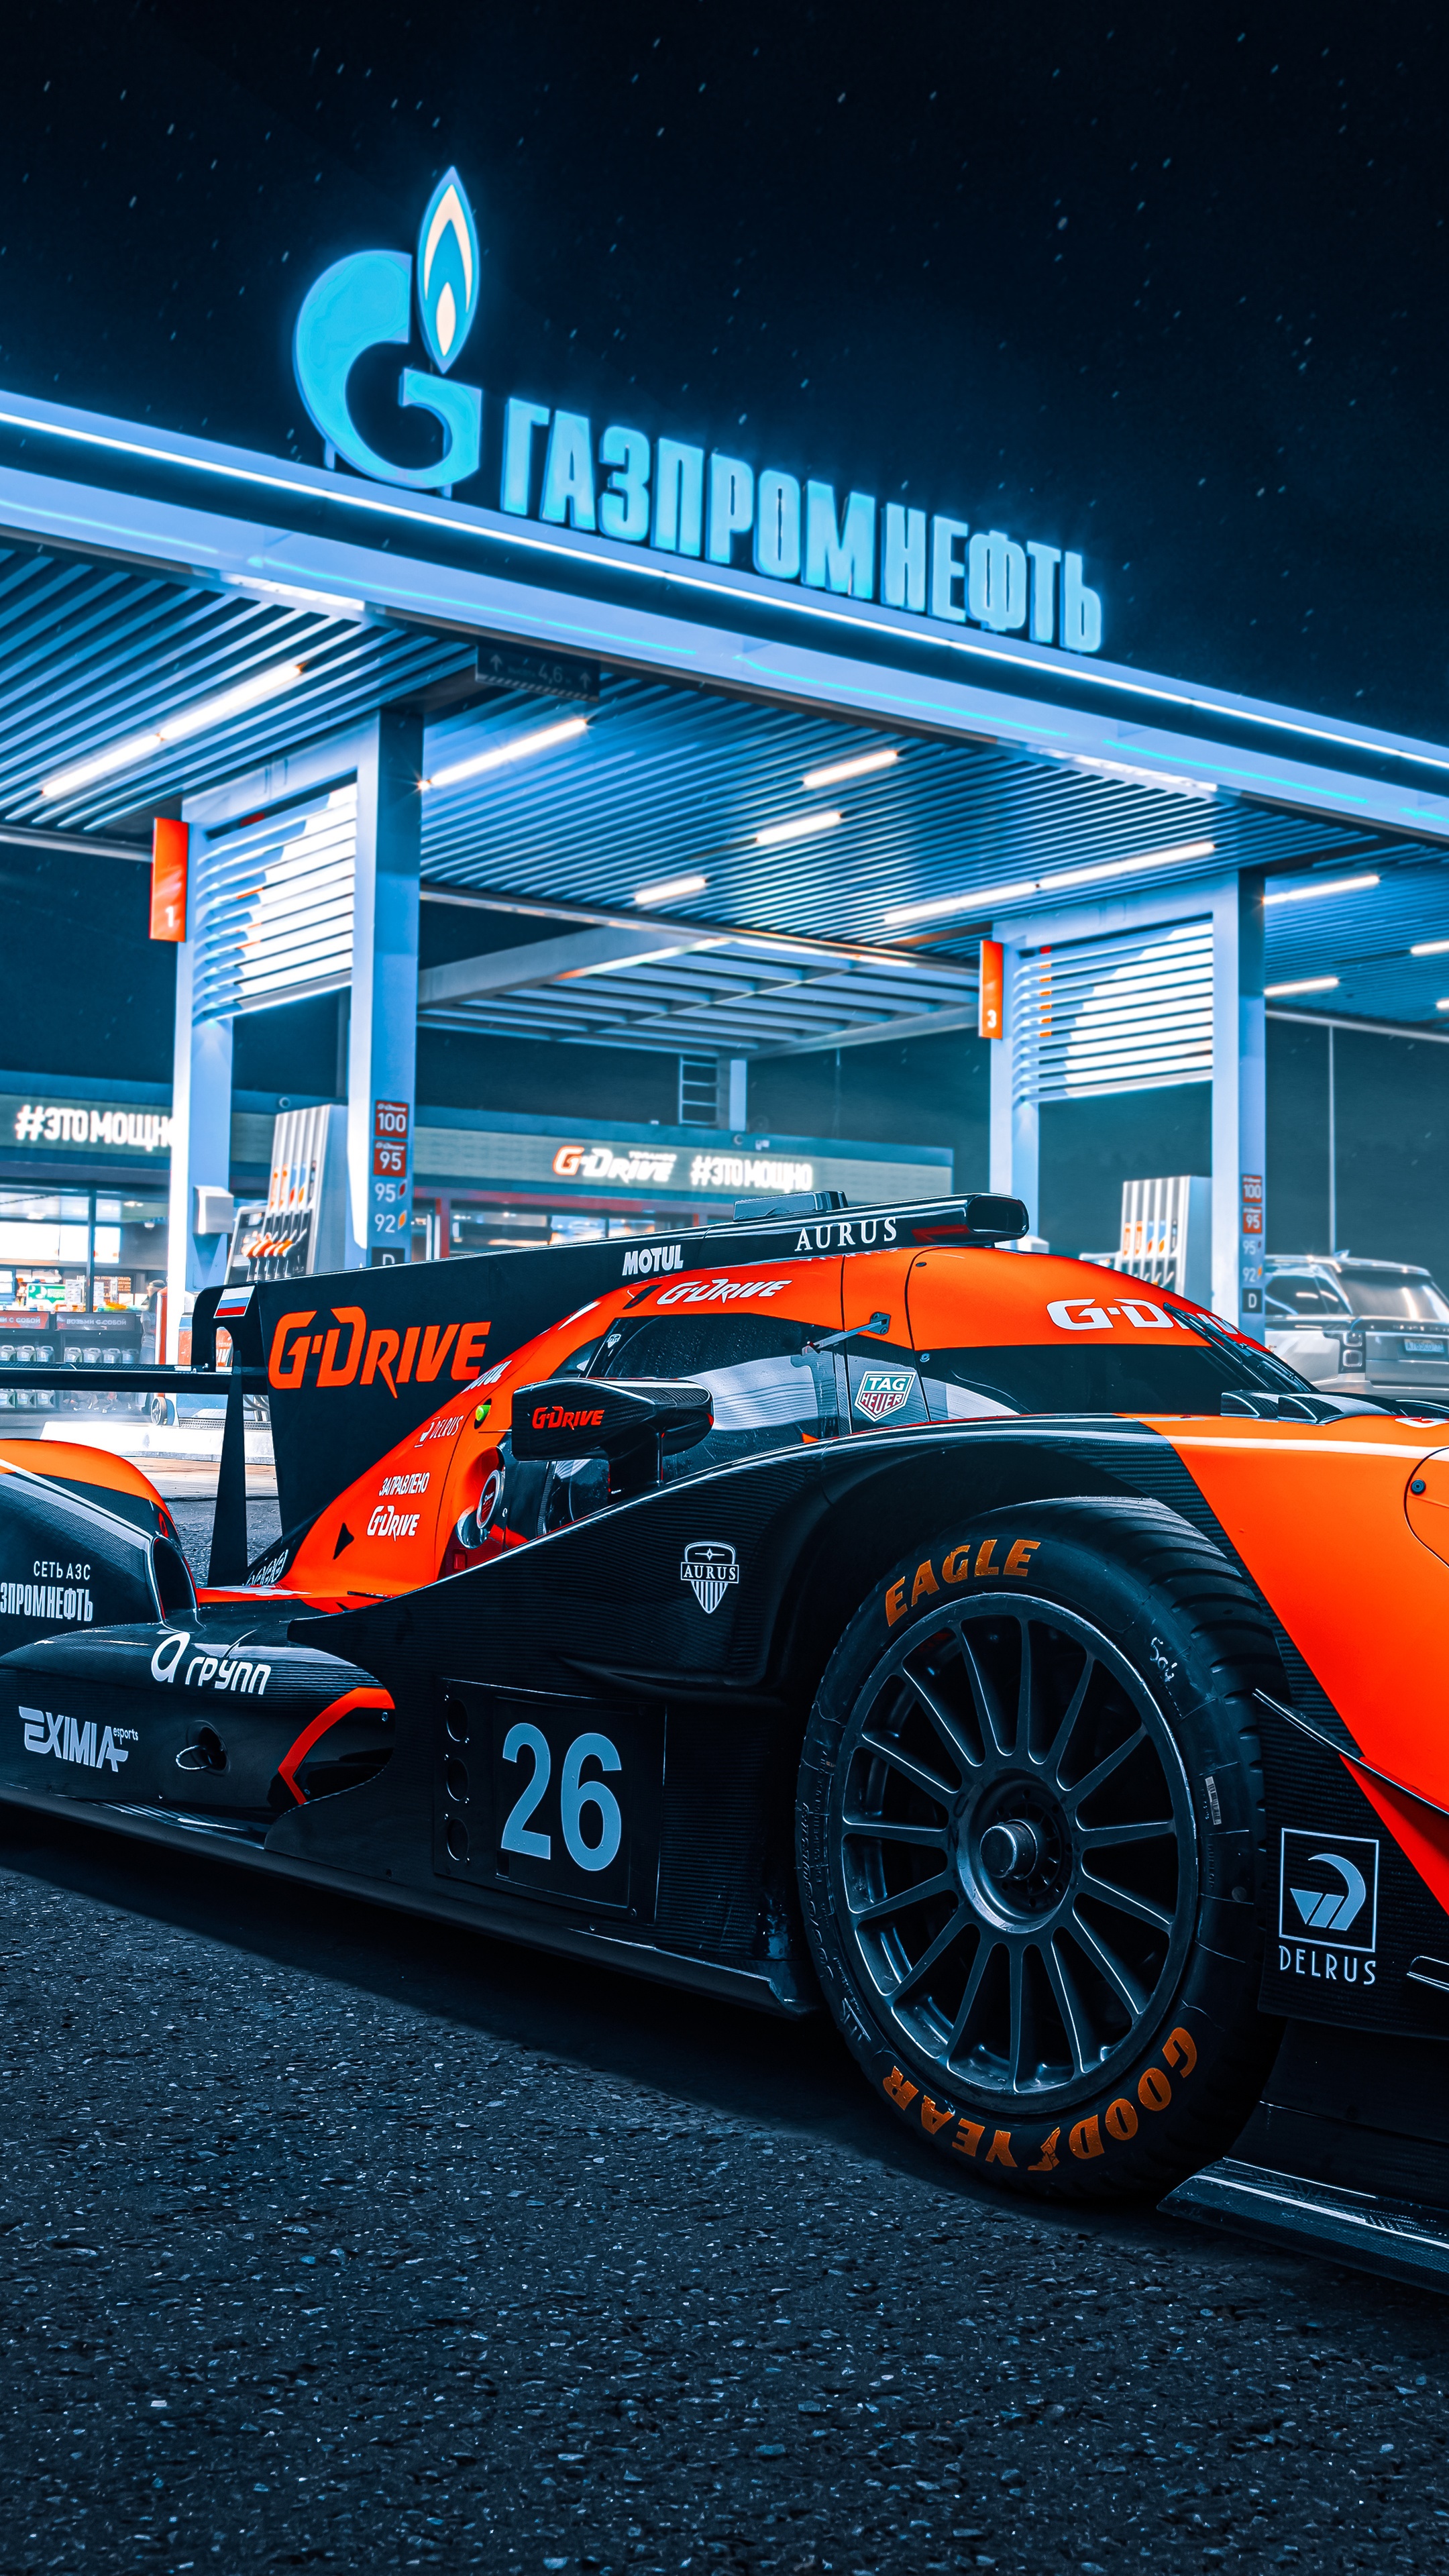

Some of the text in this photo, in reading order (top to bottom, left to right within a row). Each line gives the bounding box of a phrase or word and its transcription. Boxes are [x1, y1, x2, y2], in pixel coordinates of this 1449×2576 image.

[500, 397, 1102, 654] ГАЗПРОМНЕФТЬ
[165, 906, 174, 928] 1
[987, 1009, 997, 1028] 3
[15, 1104, 173, 1152] #ЭТОМОЩН
[378, 1112, 407, 1132] 100
[379, 1151, 402, 1171] 95
[690, 1154, 813, 1193] #ЭТОМОЩНО
[374, 1183, 396, 1203] 95
[1244, 1184, 1261, 1199] 100
[374, 1214, 396, 1233] 92
[1246, 1214, 1260, 1229] 95
[794, 1216, 897, 1252] AURUS
[1242, 1240, 1256, 1255] 95
[622, 1244, 684, 1276] MOTUL
[1242, 1267, 1256, 1283] 92
[1248, 1293, 1258, 1309] D
[103, 1318, 127, 1326] СОБОЙ
[869, 1377, 906, 1391] TAG
[861, 1393, 903, 1413] HEUER
[429, 1415, 464, 1440] DELRUS
[378, 1472, 430, 1497] ЗАПРАВЛЕНО
[34, 1560, 91, 1580] СЕТЬ АЗС
[683, 1564, 737, 1581] AURUS
[883, 1539, 1041, 1627] EAGLE
[0, 1582, 93, 1622] ЗПРОМНЕФТЬ
[19, 1706, 139, 1772] EXIMIA esports
[500, 1722, 622, 1872] 26
[1279, 1945, 1376, 1985] DELRUS
[882, 2027, 1198, 2171] GOODYEAR
